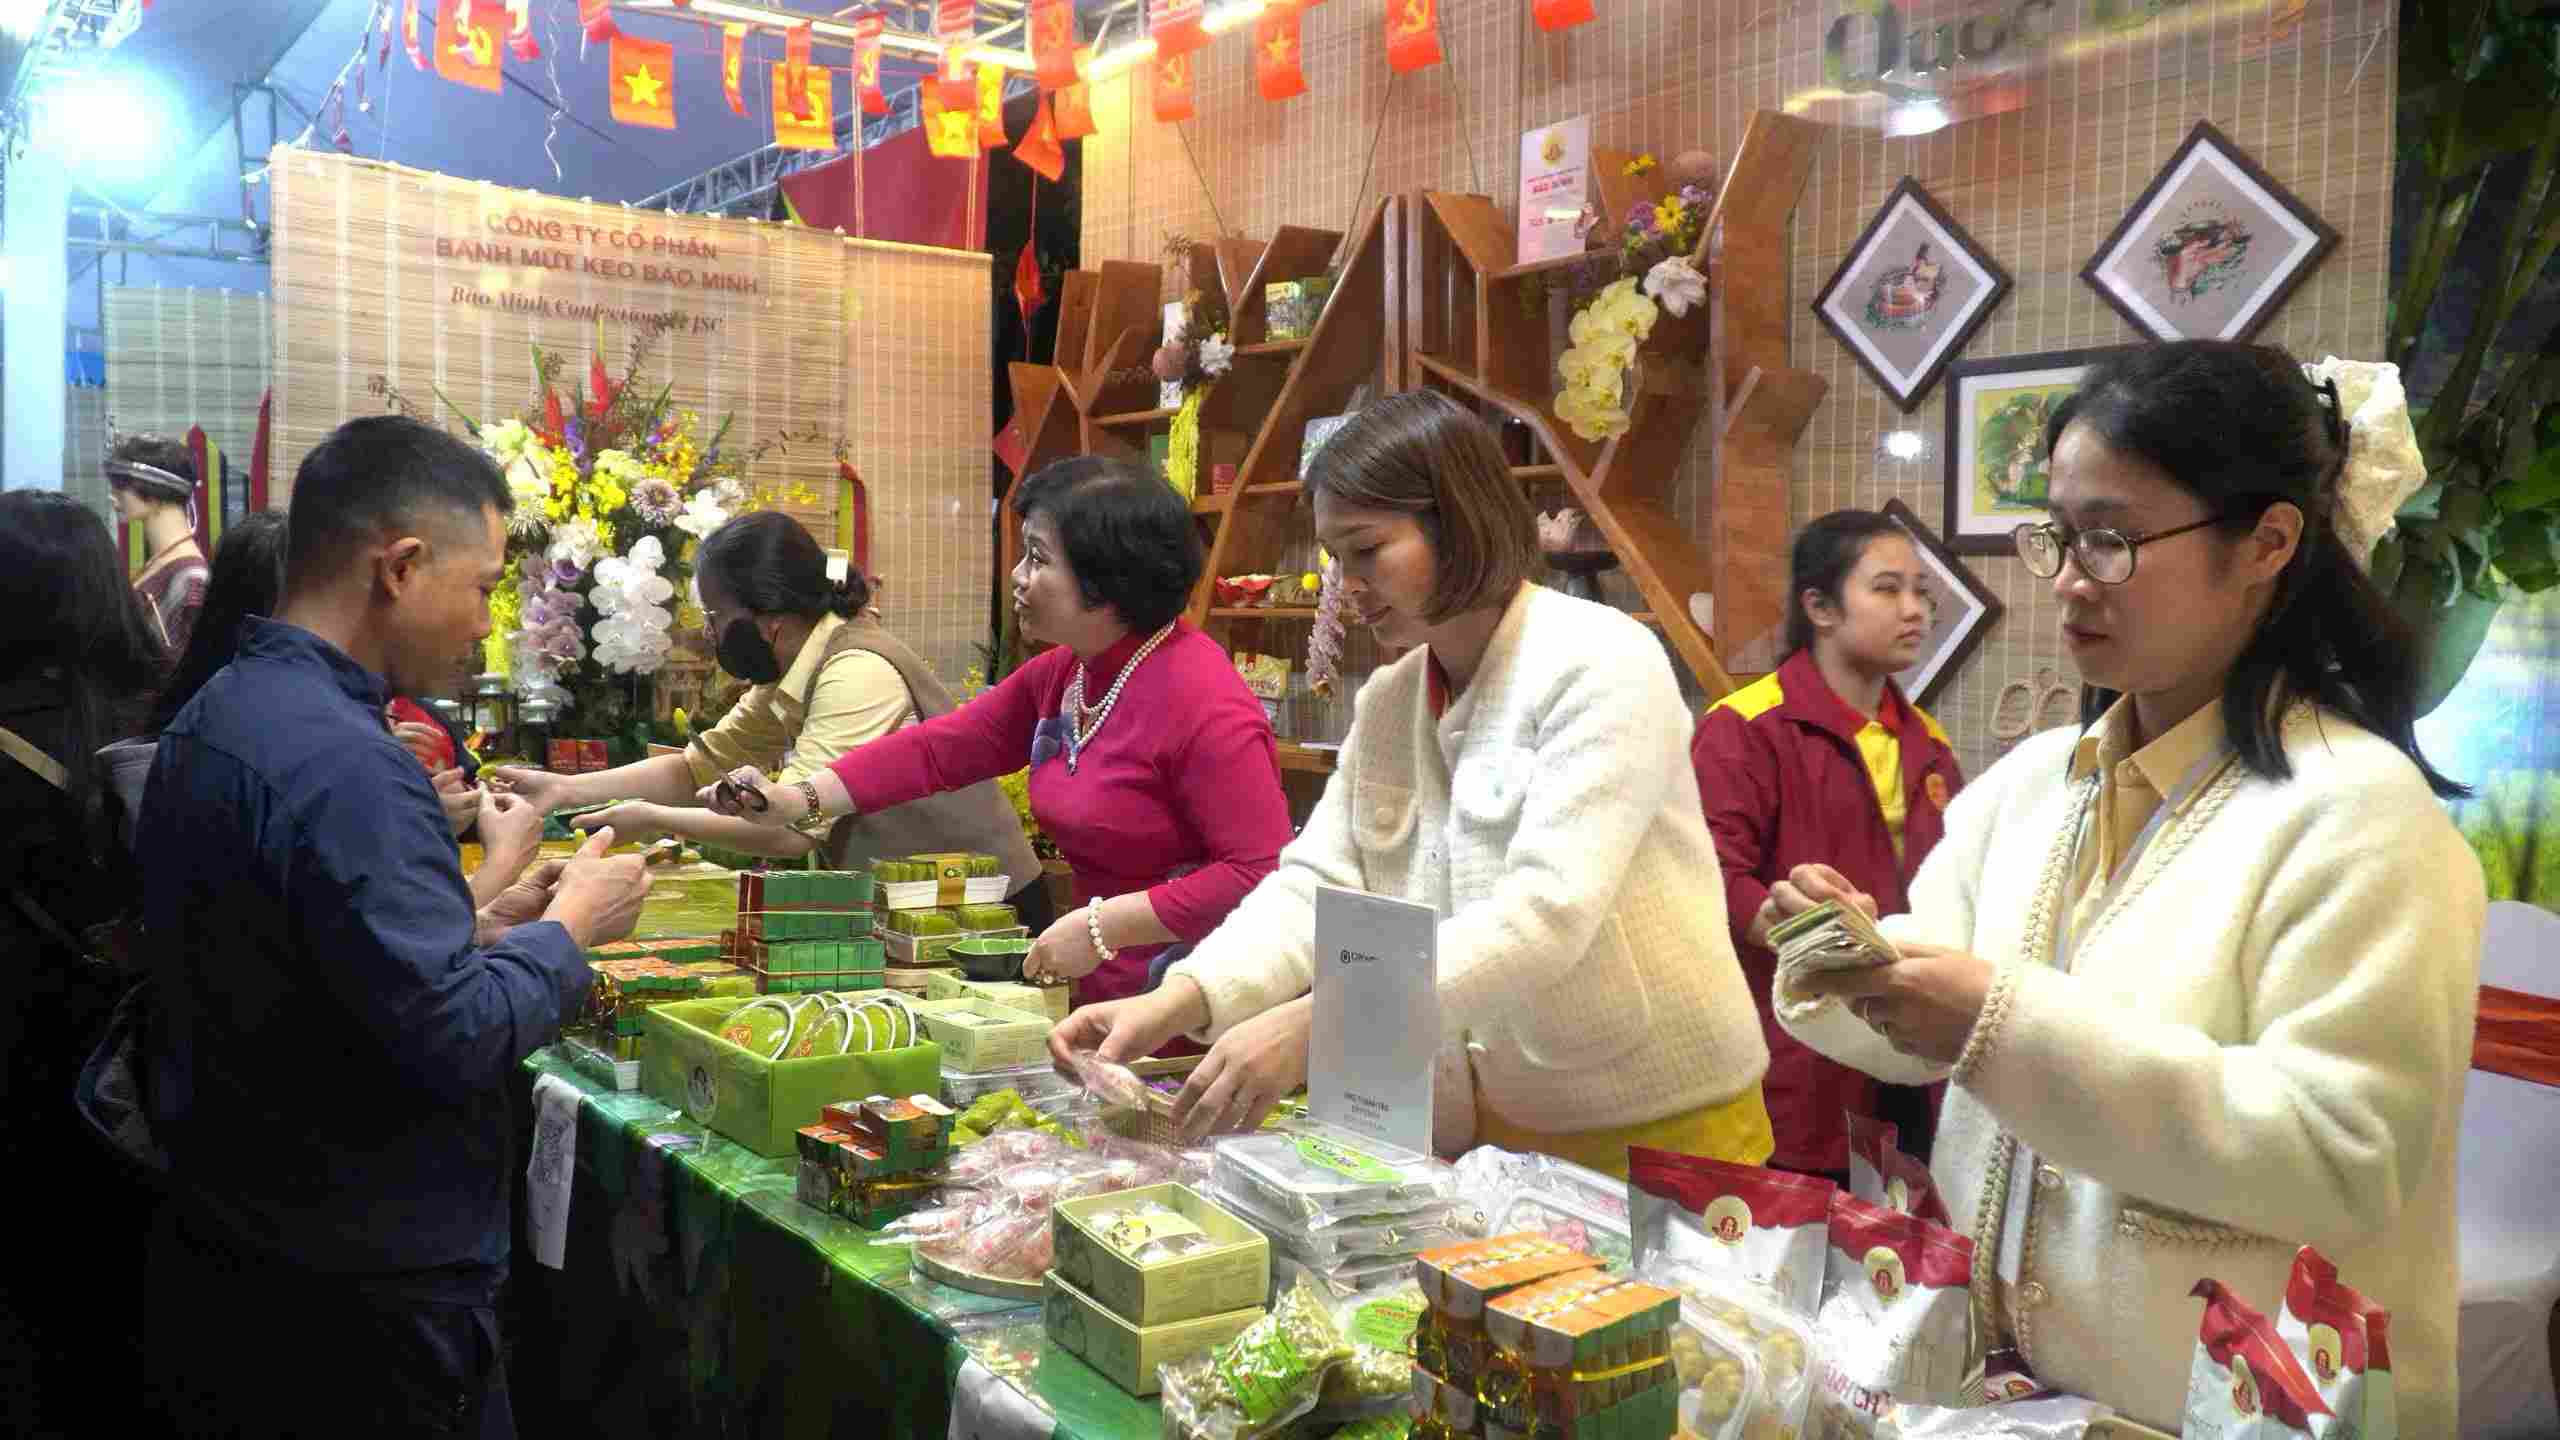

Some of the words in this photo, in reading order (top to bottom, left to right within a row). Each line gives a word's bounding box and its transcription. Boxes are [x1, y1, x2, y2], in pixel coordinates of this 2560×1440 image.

[488, 210, 561, 241] CÔNG
[572, 223, 600, 244] TY
[702, 271, 758, 294] MINH
